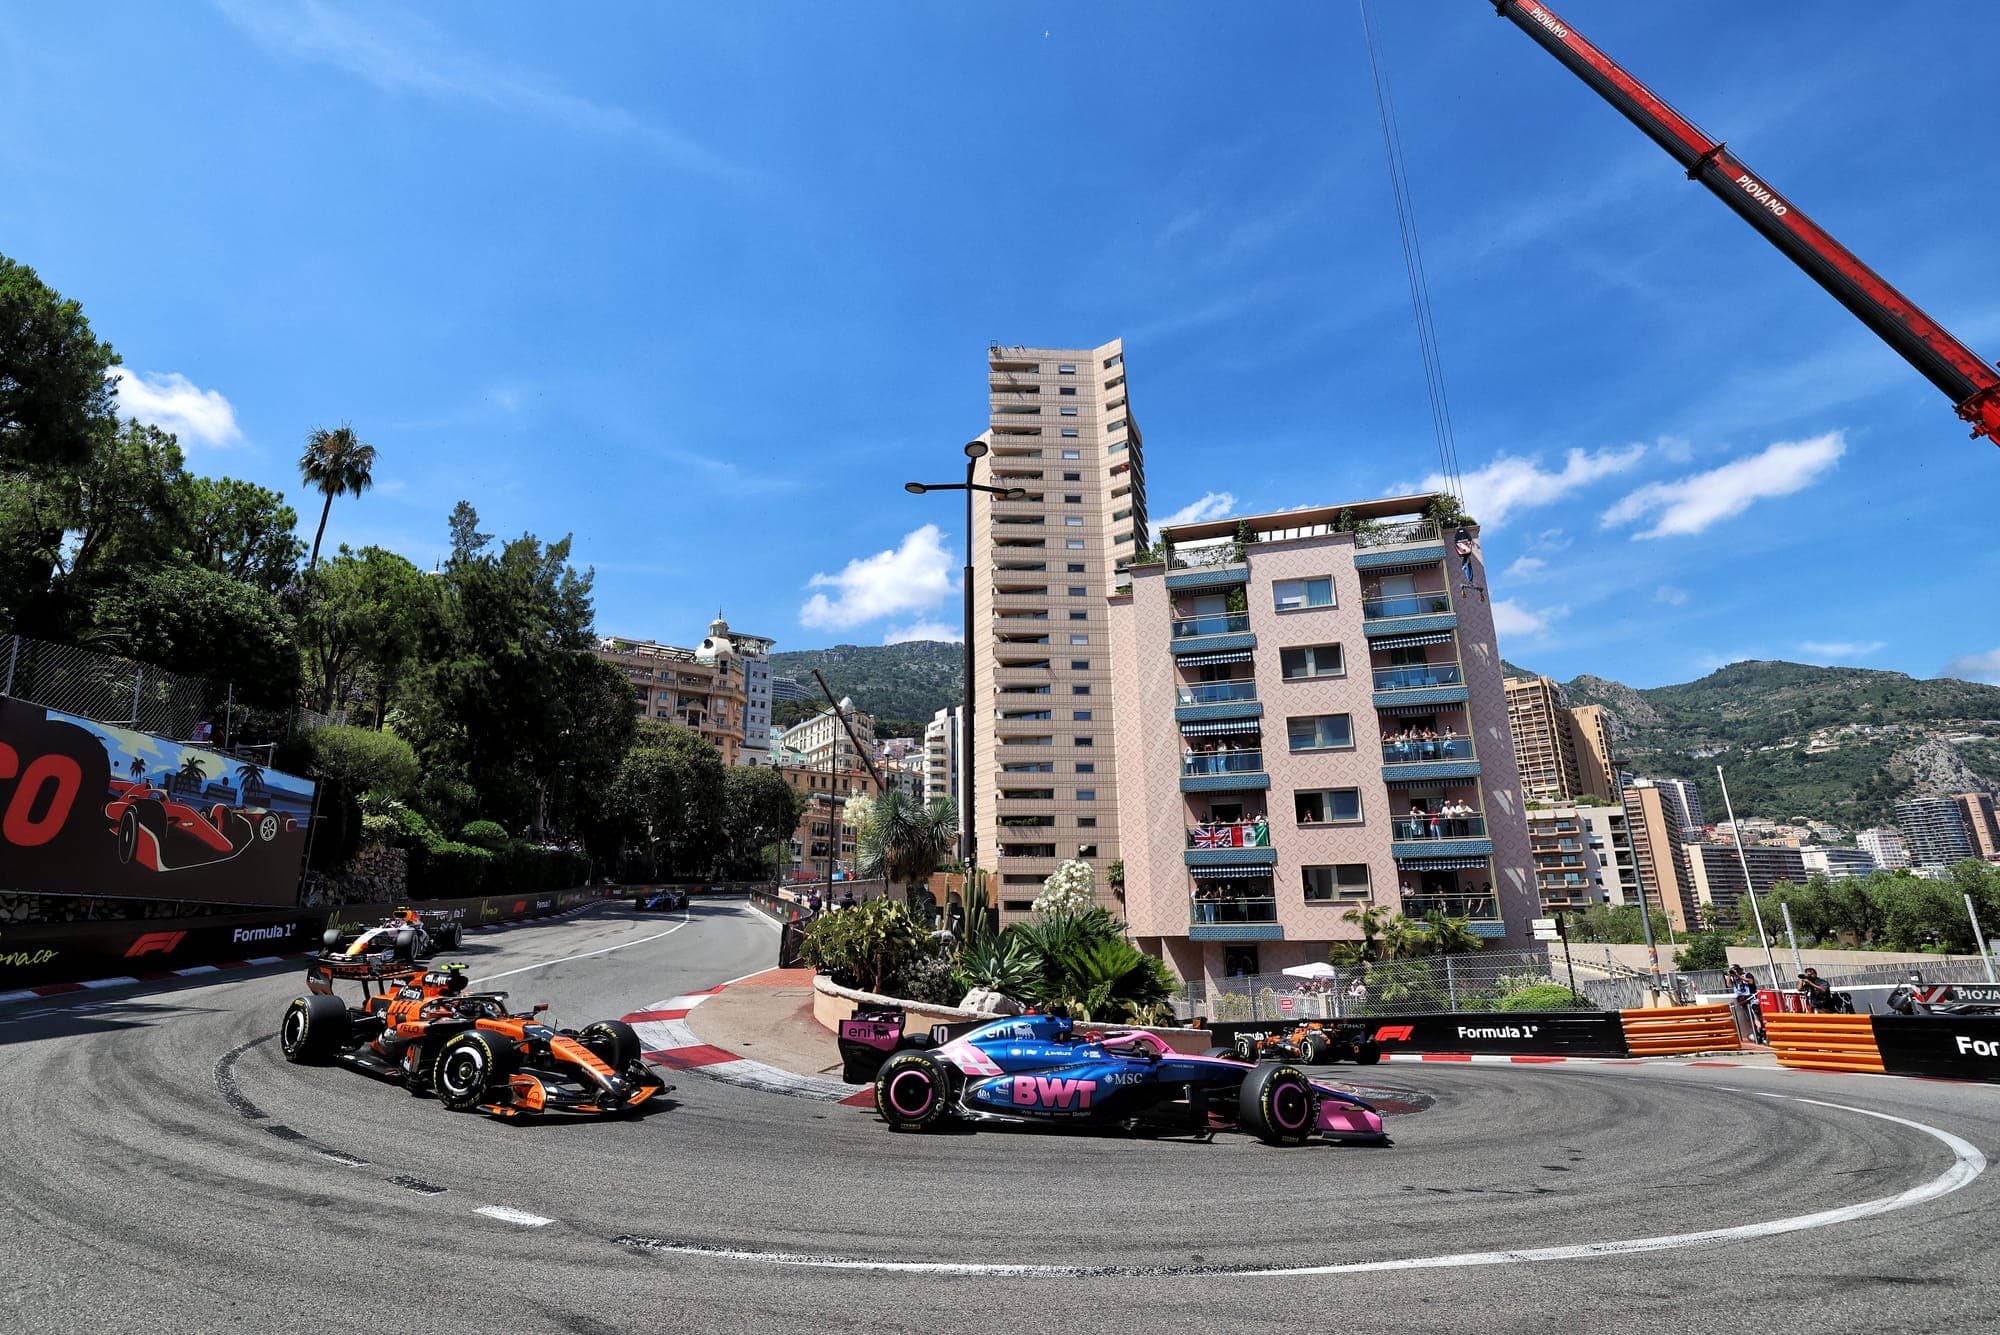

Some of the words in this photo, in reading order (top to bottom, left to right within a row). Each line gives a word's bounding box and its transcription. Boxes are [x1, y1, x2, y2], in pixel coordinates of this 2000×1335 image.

[1530, 7, 1568, 38] PIOVANO
[1735, 174, 1788, 216] PIOVANO
[233, 925, 282, 943] Formula
[848, 1025, 871, 1038] eni
[932, 1025, 949, 1044] 10
[985, 1027, 1011, 1039] eni
[1457, 1026, 1520, 1039] Formula
[1955, 1036, 2000, 1057] For
[1114, 1072, 1143, 1085] MSC
[1013, 1075, 1097, 1109] BWT
